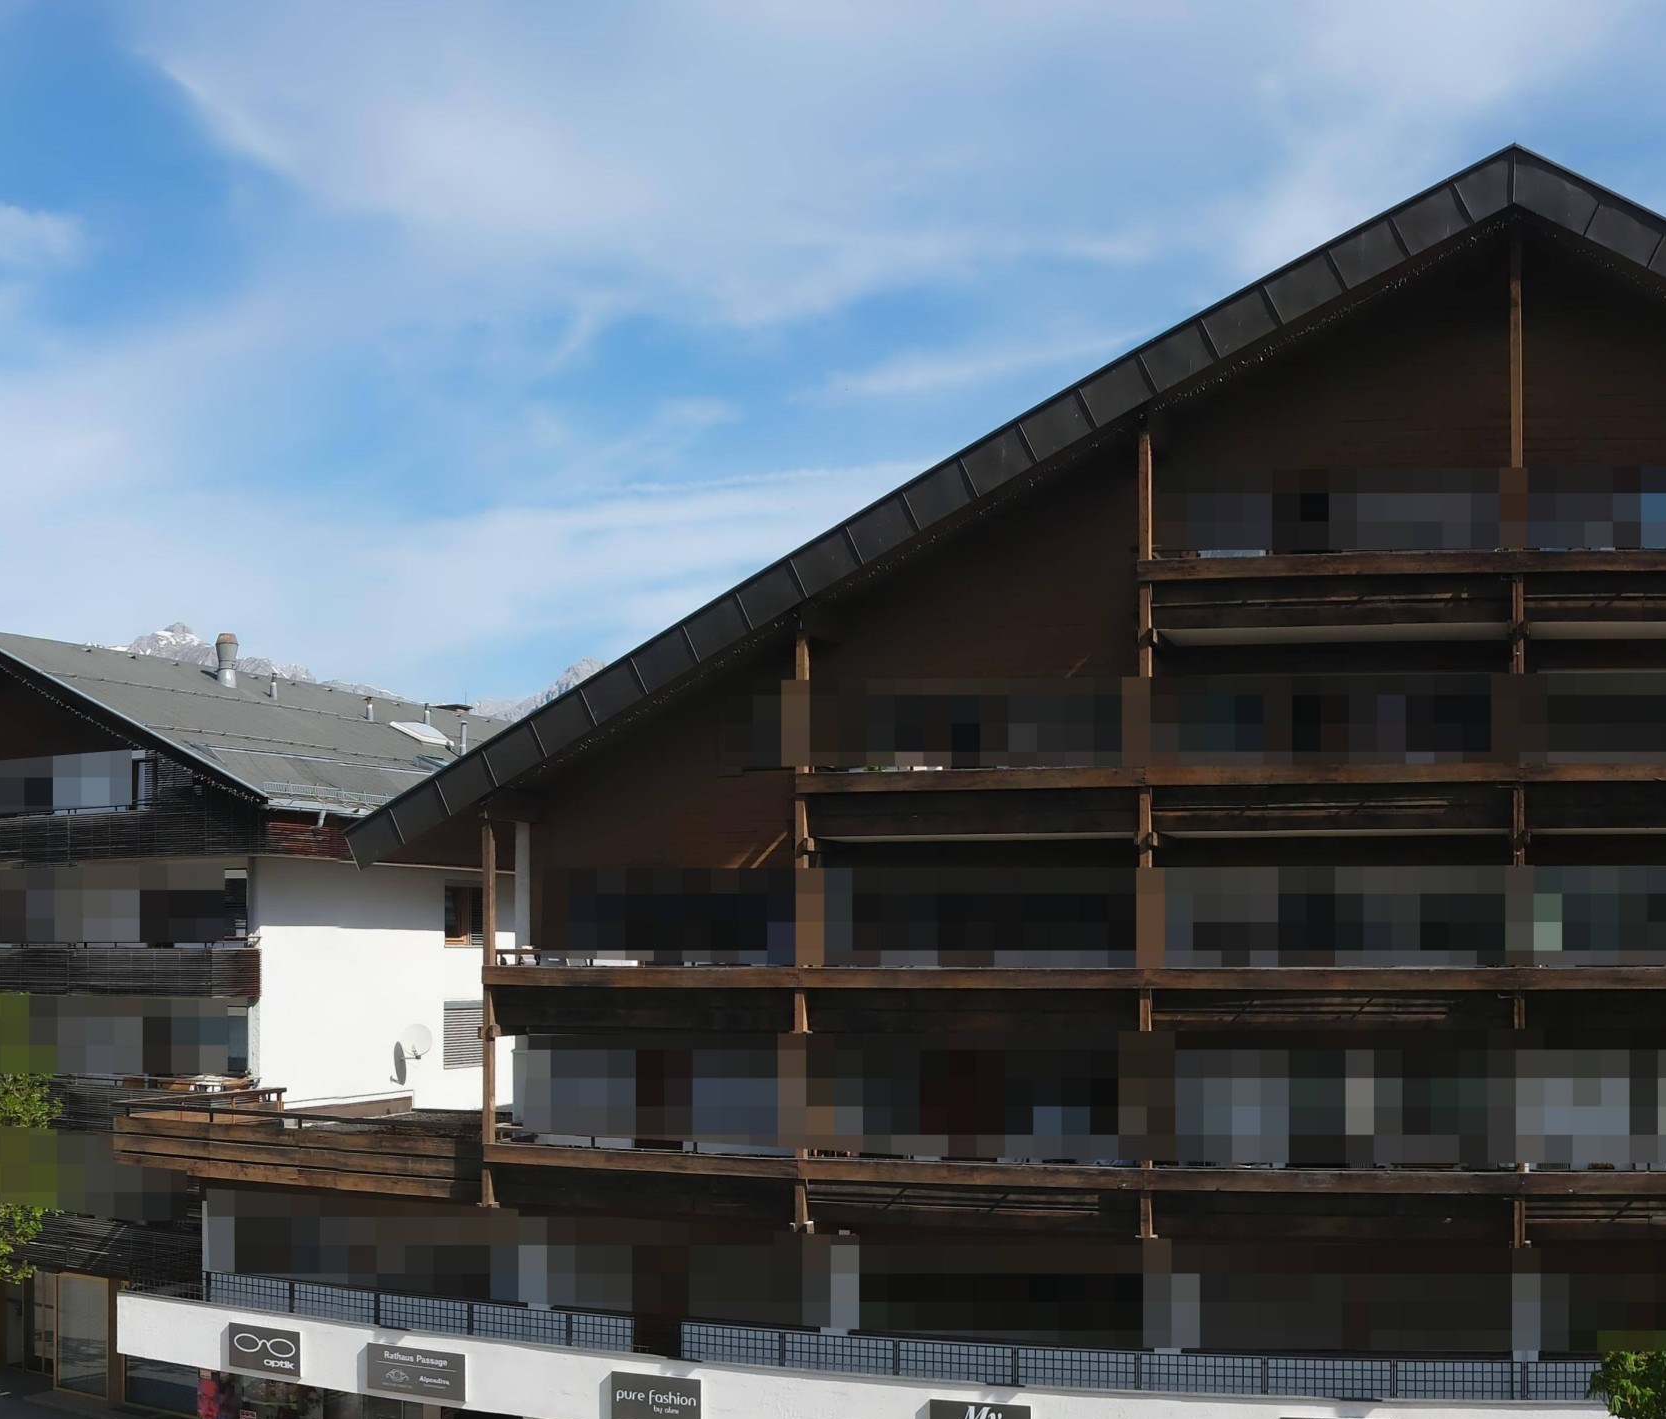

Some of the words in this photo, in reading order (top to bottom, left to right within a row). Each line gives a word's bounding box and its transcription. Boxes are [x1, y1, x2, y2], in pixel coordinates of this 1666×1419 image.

[263, 1358, 295, 1370] optik
[383, 1350, 415, 1363] Rathaus
[416, 1354, 448, 1368] Passage
[616, 1389, 646, 1402] pure
[648, 1389, 697, 1407] fashion
[653, 1405, 663, 1414] by
[664, 1406, 680, 1415] alex
